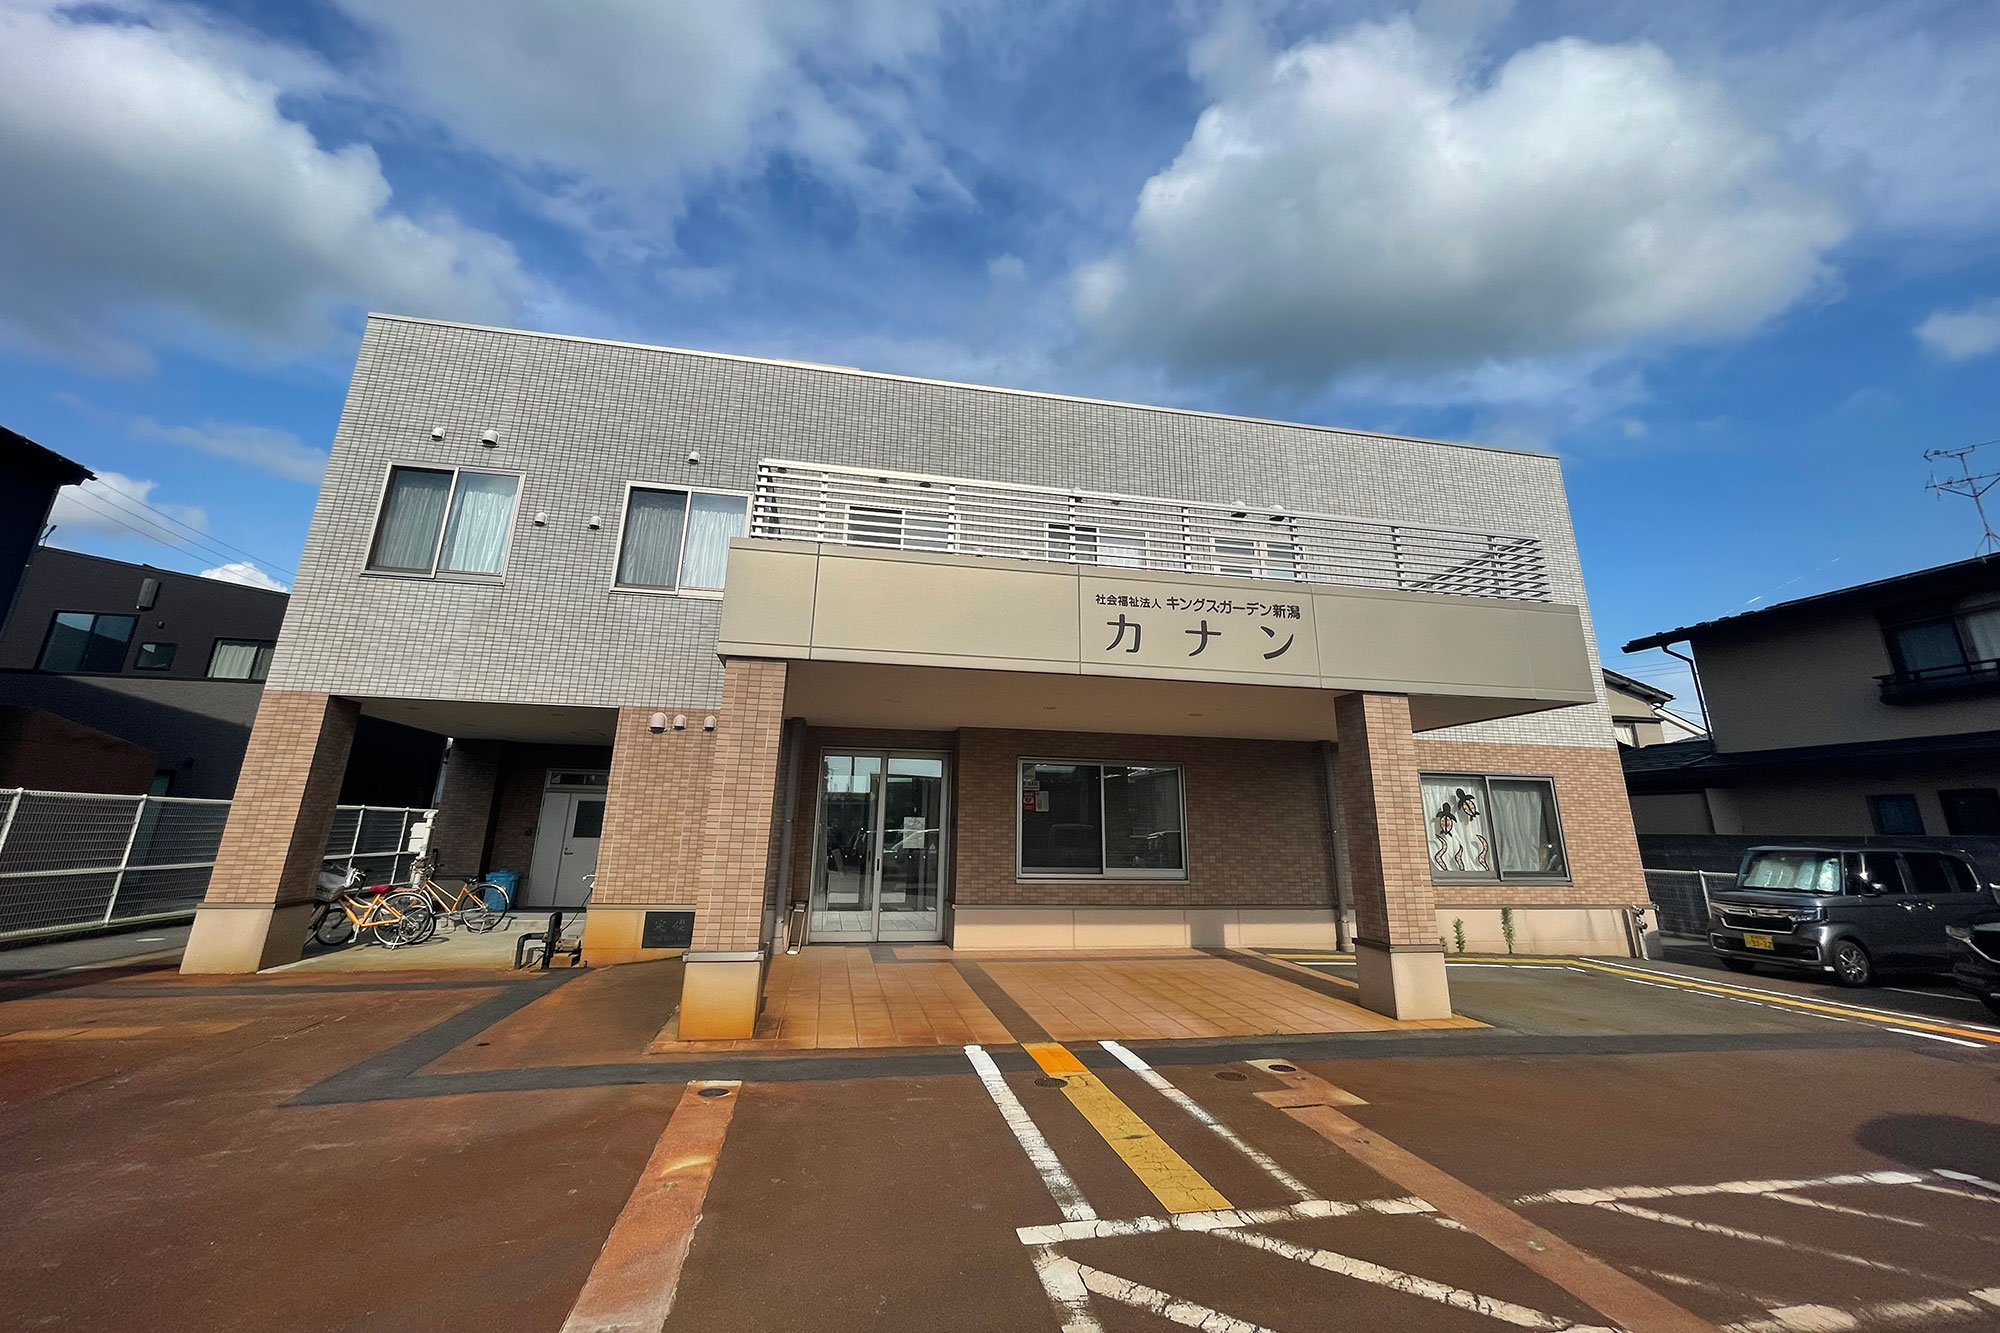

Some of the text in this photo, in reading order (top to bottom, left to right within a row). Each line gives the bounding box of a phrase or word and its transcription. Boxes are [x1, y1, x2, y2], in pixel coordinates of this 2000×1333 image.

[1096, 594, 1162, 609] 社会福祉法人
[1106, 613, 1294, 660] カナン
